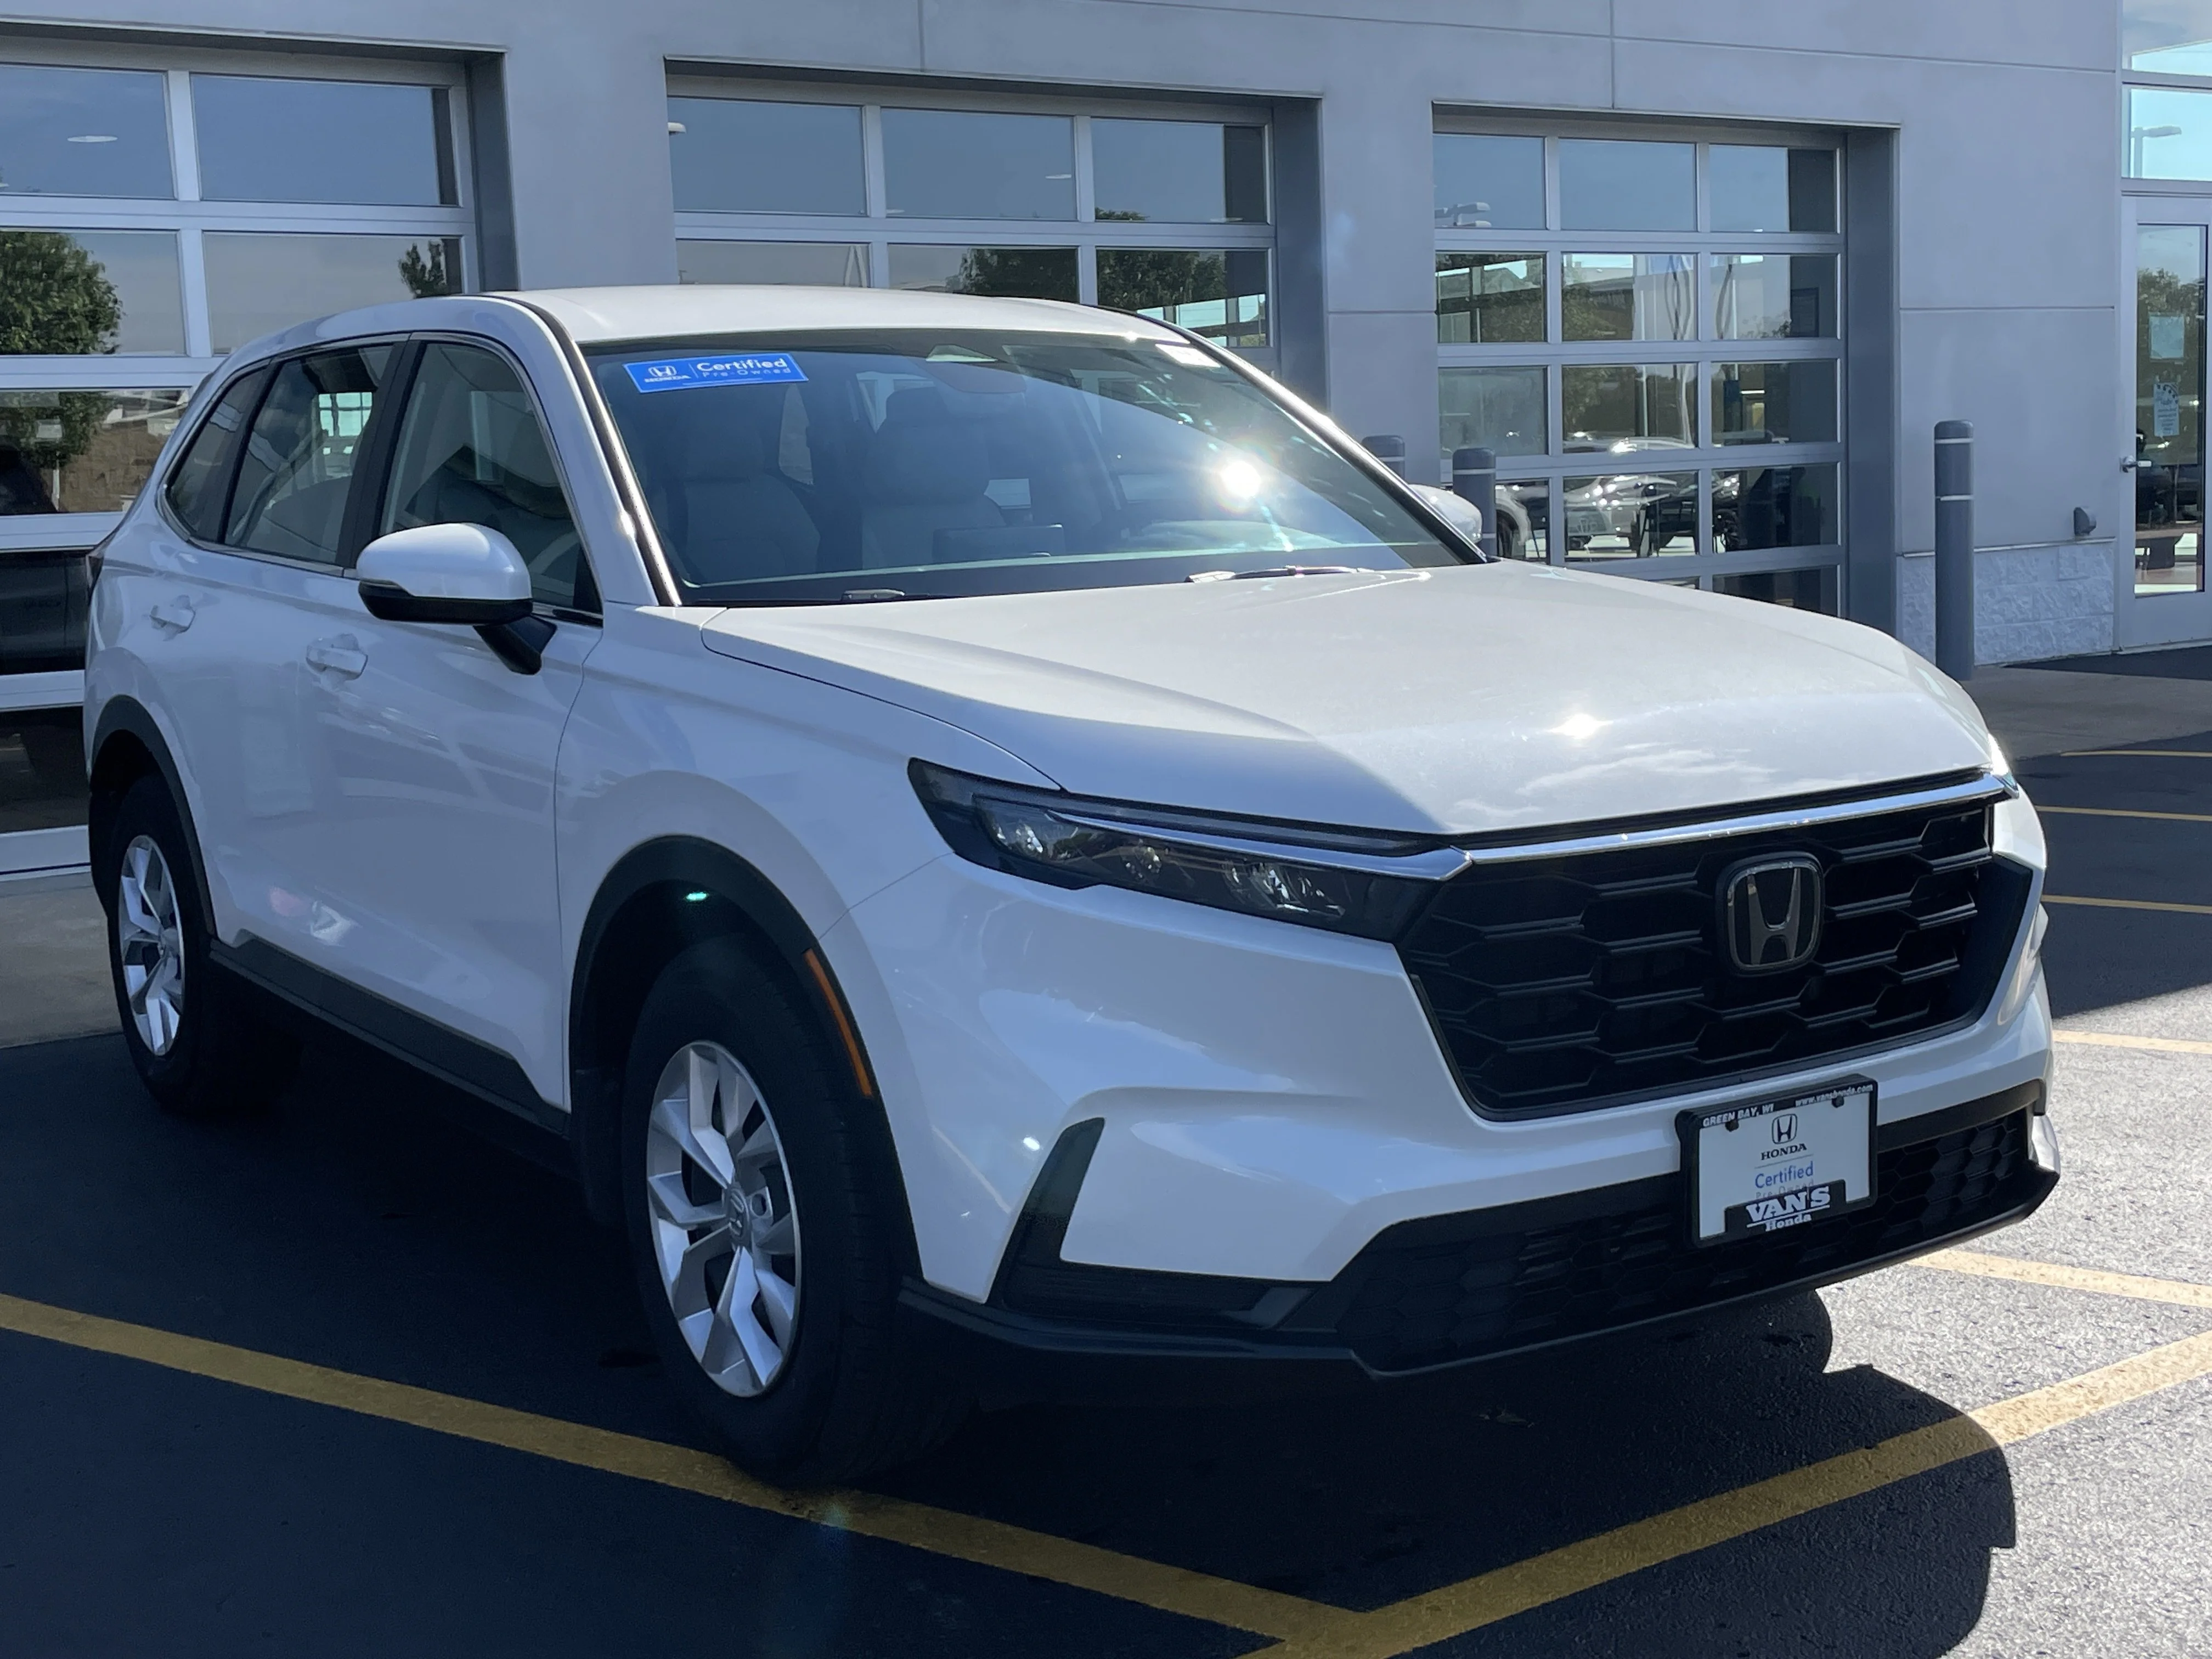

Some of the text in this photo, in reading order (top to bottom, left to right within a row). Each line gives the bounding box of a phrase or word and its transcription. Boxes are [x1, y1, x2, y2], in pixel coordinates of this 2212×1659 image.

[696, 358, 788, 372] Certified
[702, 368, 791, 377] Pre-Owned
[1702, 1111, 1736, 1127] GREEN
[1737, 1106, 1759, 1119] BAY,
[1762, 1103, 1775, 1114] WI
[1760, 1143, 1807, 1160] HONDA
[1755, 1160, 1813, 1188] Certified
[1765, 1213, 1812, 1232] Honda
